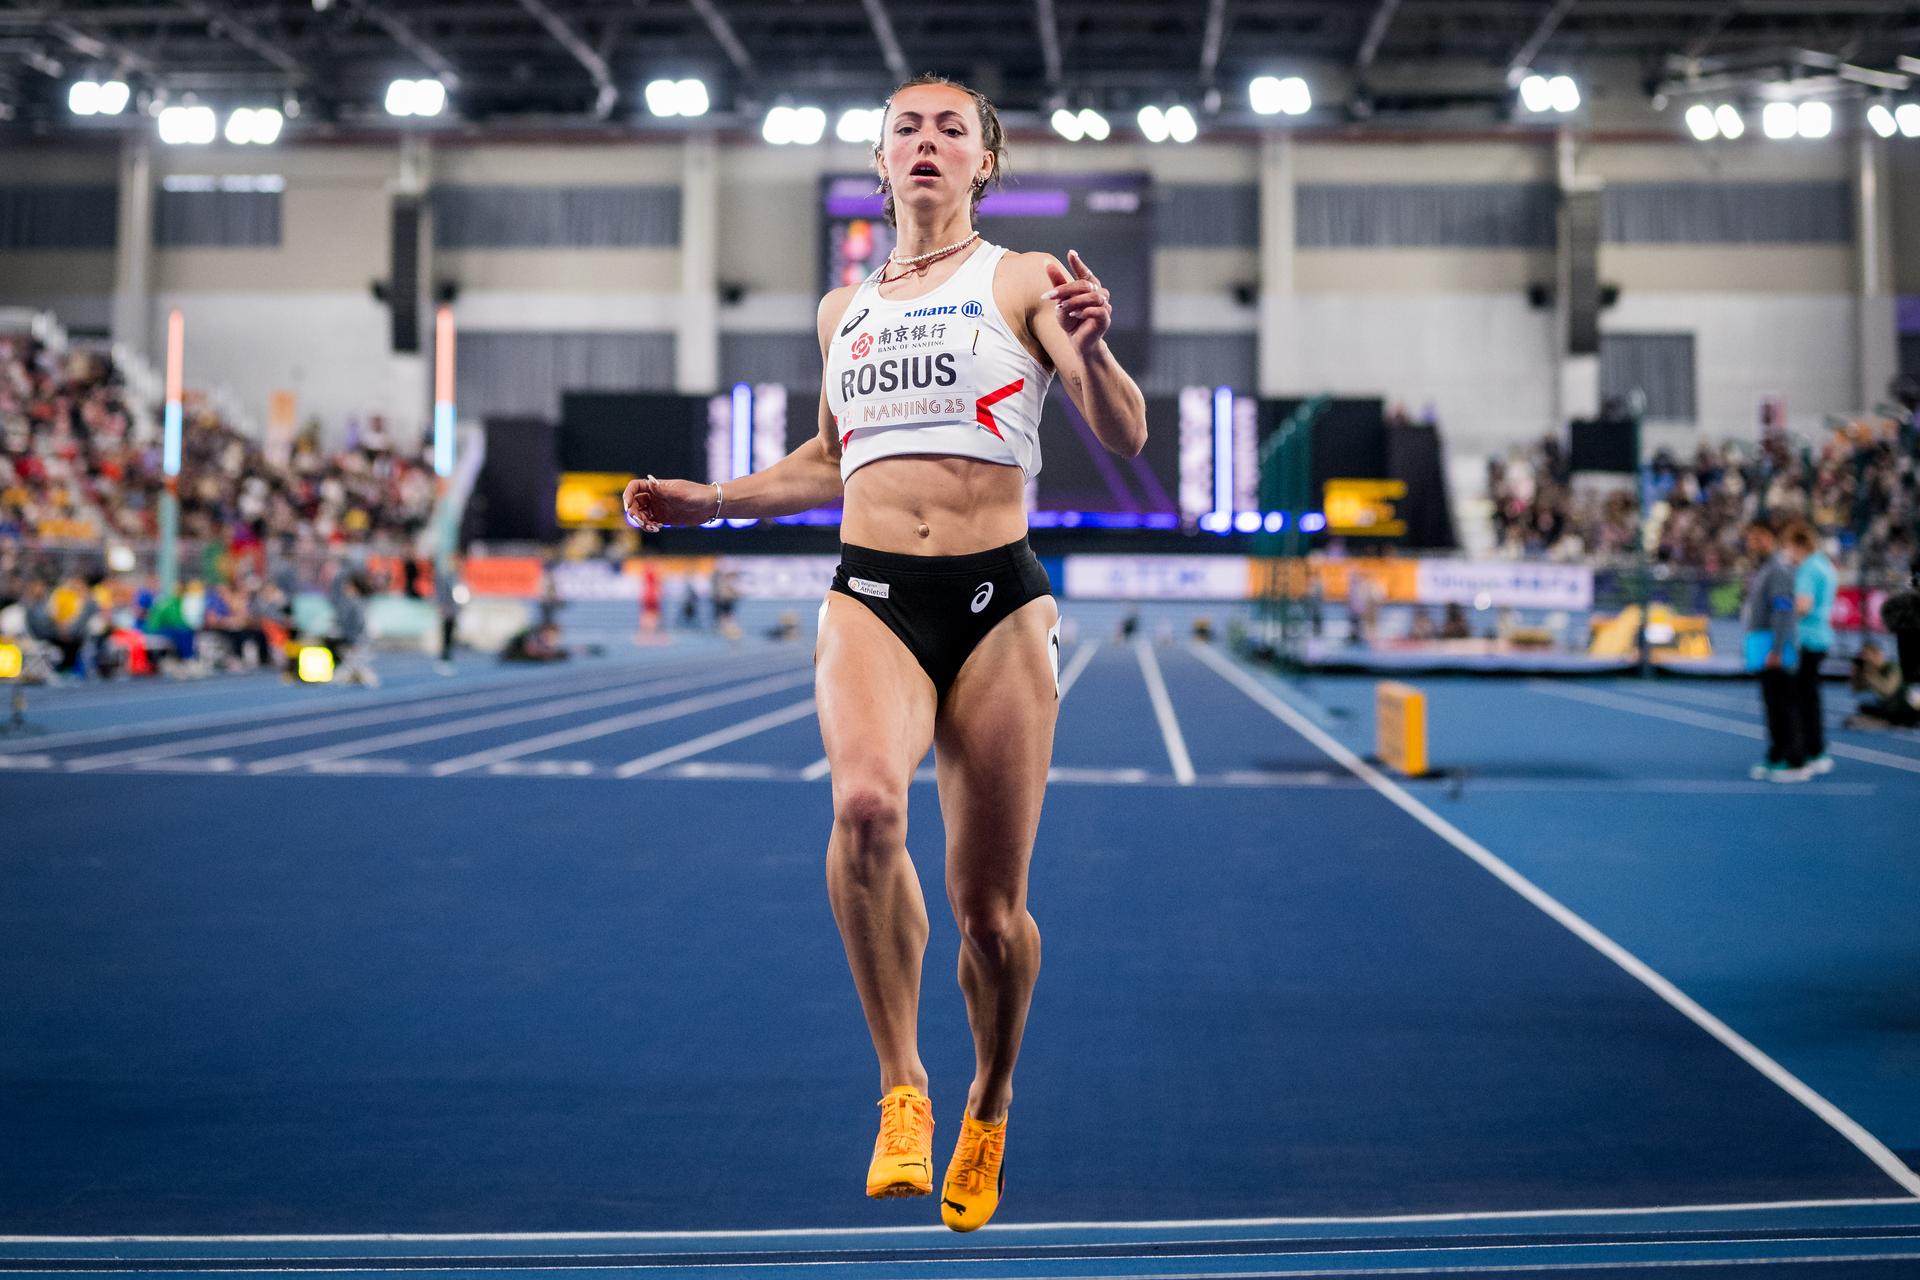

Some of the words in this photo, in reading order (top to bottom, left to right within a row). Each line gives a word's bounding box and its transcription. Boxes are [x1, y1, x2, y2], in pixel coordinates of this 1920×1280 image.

[878, 323, 947, 345] 南京银行
[878, 345, 897, 353] BANK
[911, 340, 944, 349] NANJING
[841, 353, 957, 403] ROSIUS
[945, 398, 965, 413] 25
[860, 587, 887, 596] Athletics
